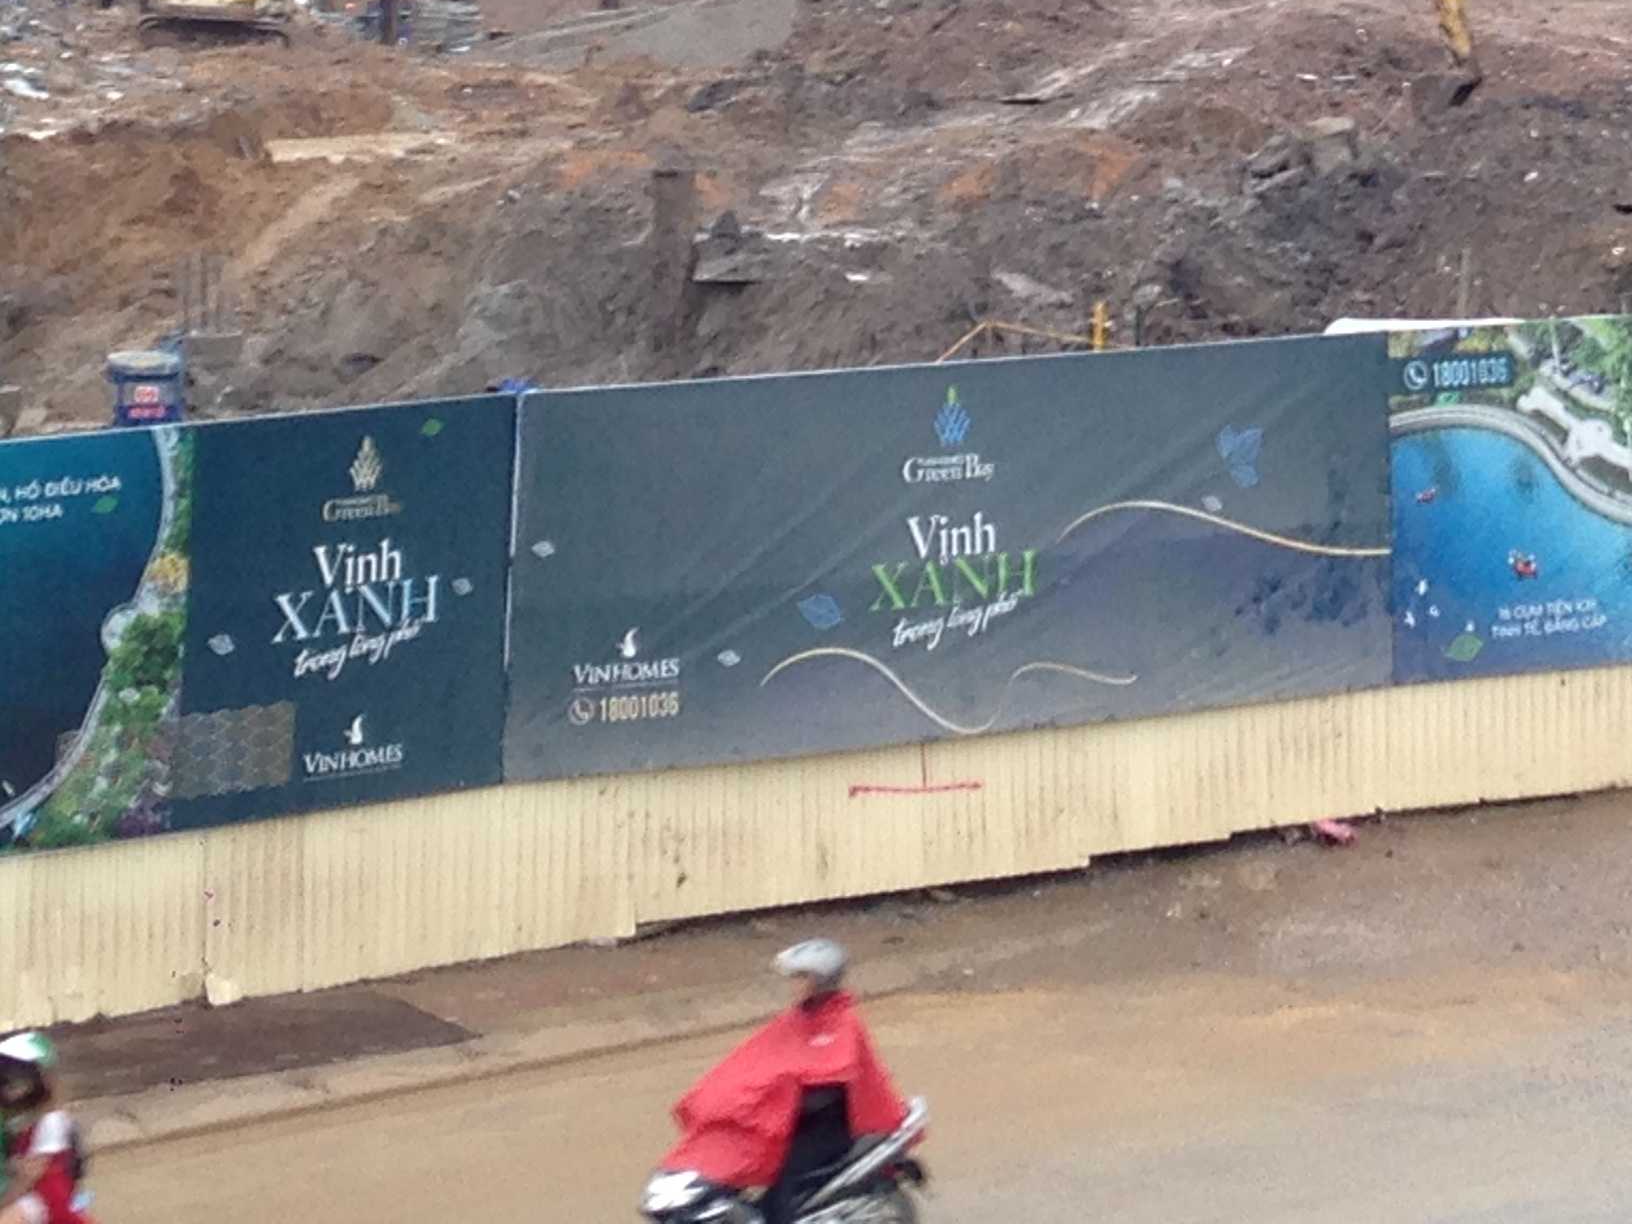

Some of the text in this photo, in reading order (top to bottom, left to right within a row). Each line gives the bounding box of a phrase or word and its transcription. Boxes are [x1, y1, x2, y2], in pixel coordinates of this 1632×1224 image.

[313, 537, 402, 595] Vịnh
[907, 511, 997, 566] Vịnh
[868, 549, 1039, 612] XANH
[271, 575, 440, 645] XANH
[574, 657, 680, 685] VINHOMES
[599, 691, 680, 723] 18001036
[303, 744, 403, 773] VINHOMES
